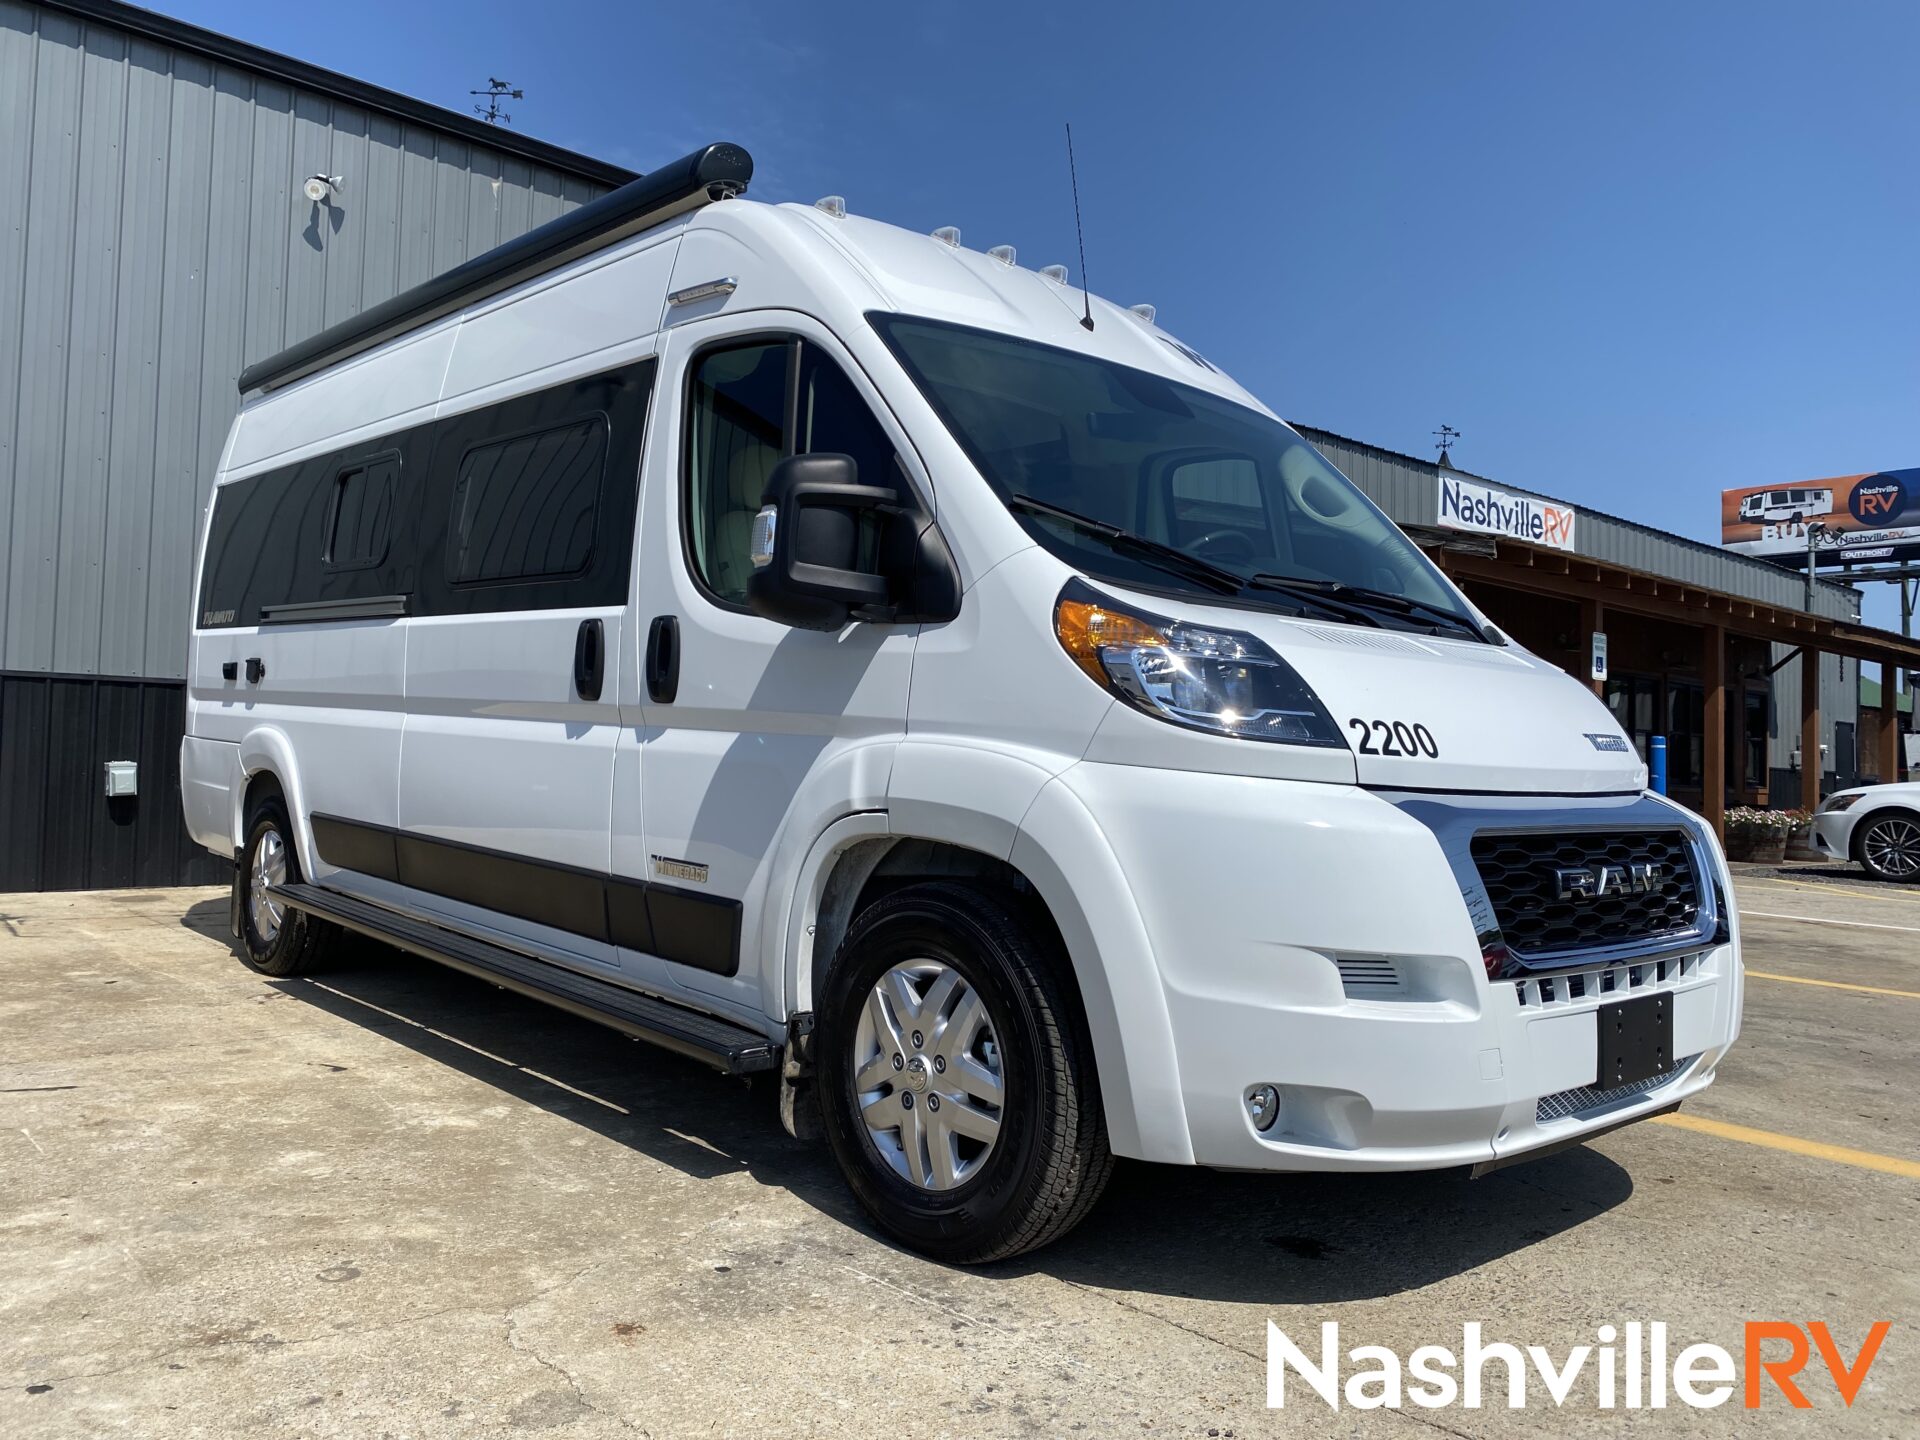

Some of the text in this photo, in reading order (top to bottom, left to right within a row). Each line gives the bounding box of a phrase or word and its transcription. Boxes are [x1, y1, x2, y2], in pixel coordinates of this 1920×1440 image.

[1860, 485, 1899, 495] Nashville
[1860, 492, 1898, 515] RV
[1442, 477, 1572, 544] NashvilleRV
[1349, 717, 1439, 759] 2200
[1556, 863, 1662, 899] RAM
